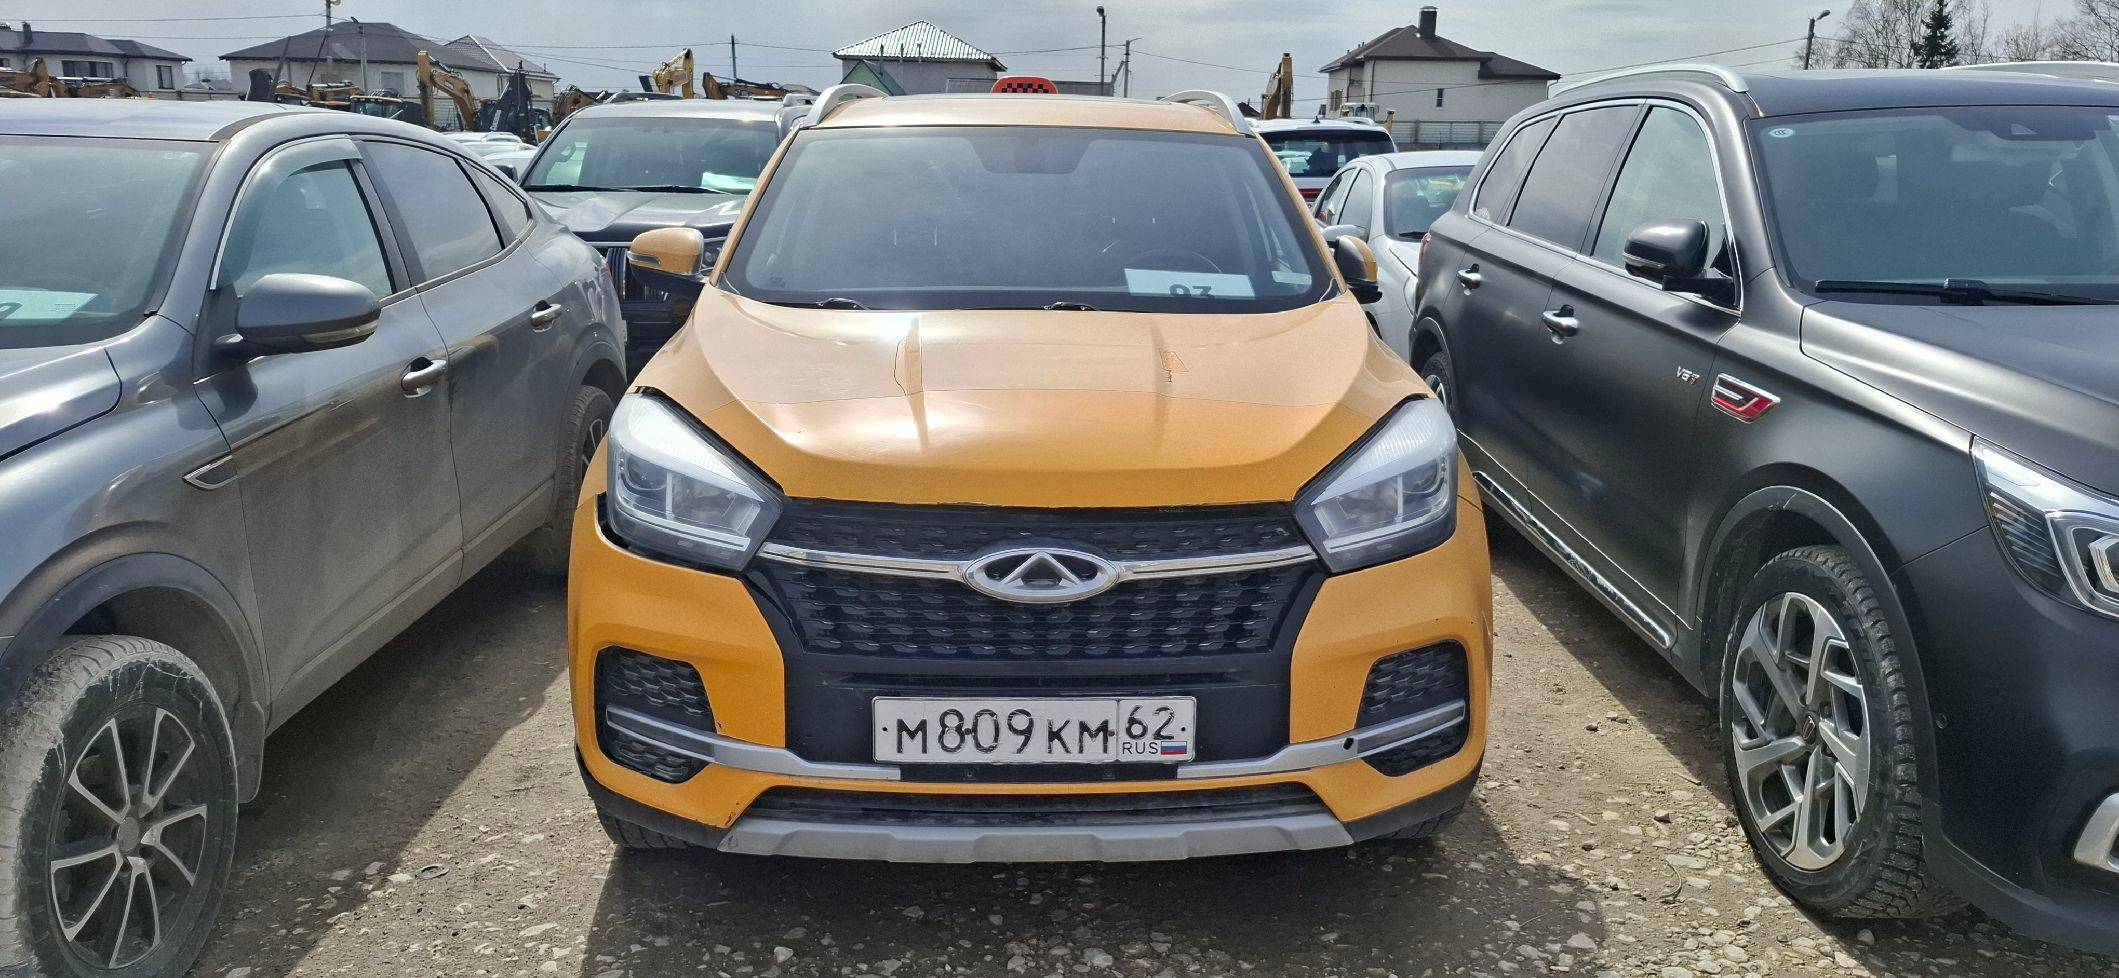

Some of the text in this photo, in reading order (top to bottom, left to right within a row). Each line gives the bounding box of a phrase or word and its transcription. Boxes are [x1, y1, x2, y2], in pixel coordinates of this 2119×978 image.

[897, 704, 1175, 754] М809КМ 62
[1122, 741, 1159, 755] RUS
